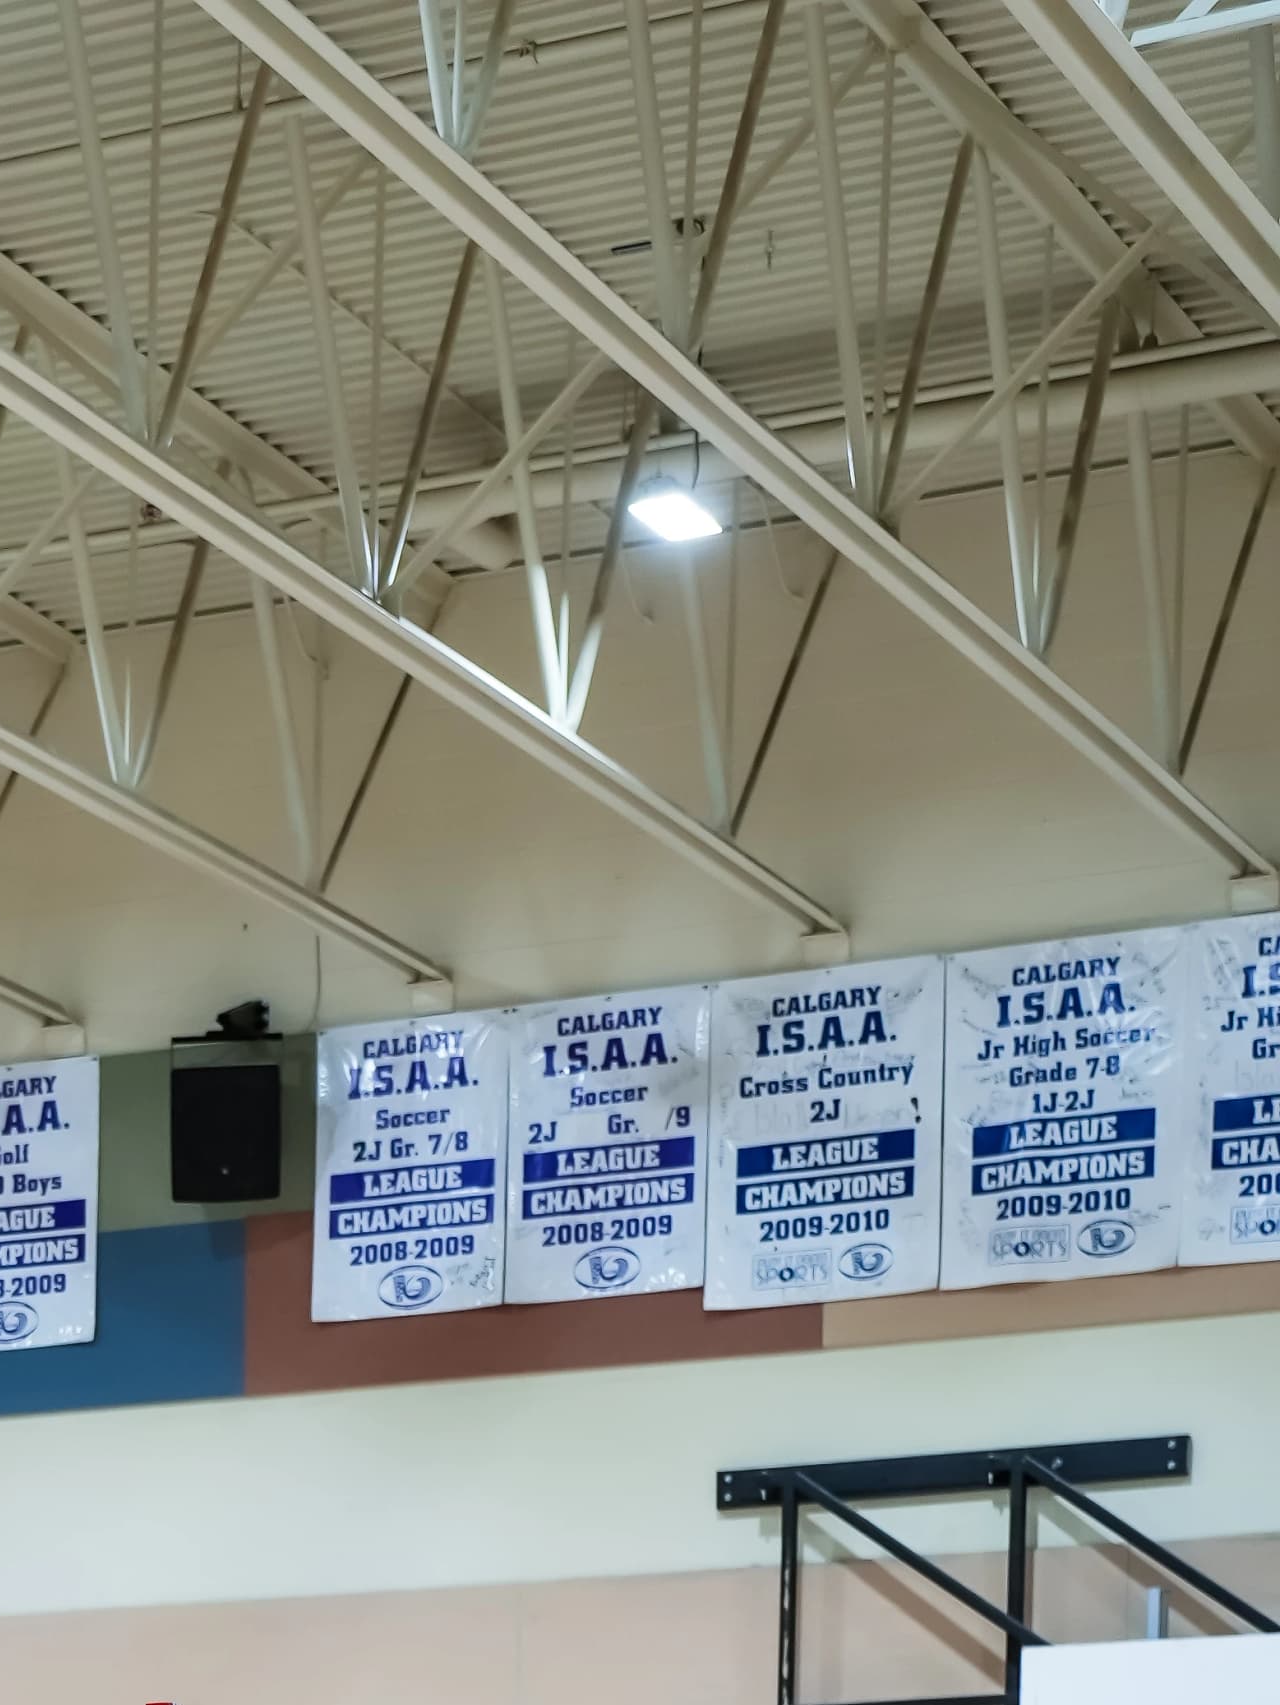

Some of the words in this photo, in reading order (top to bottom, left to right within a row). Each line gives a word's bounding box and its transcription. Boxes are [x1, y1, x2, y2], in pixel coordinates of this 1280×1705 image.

[1012, 956, 1121, 988] CALGARY
[771, 985, 882, 1019] CALGARY
[997, 982, 1137, 1028] I.S.A.A.
[557, 1006, 662, 1038] CALGARY
[756, 1010, 897, 1058] I.S.A.A.
[1220, 1010, 1248, 1032] Jr
[363, 1030, 464, 1060] CALGARY
[542, 1032, 678, 1078] I.S.A.A.
[977, 1039, 1005, 1062] Jr
[1013, 1030, 1067, 1059] High
[1076, 1024, 1157, 1050] Soccer
[348, 1056, 479, 1100] I.S.A.A.
[740, 1076, 809, 1100] Cross
[818, 1062, 915, 1090] Country
[1009, 1060, 1077, 1089] Grade
[1085, 1054, 1121, 1079] 7-8
[570, 1086, 649, 1109] Soccer
[810, 1099, 841, 1125] 2J
[1032, 1089, 1096, 1115] 1J-2J
[376, 1108, 451, 1130] Soccer
[528, 1121, 557, 1145] 2J
[607, 1114, 640, 1136] Gr.
[1008, 1115, 1118, 1151] LEAGUE
[353, 1140, 381, 1163] 2J
[390, 1138, 419, 1160] Gr.
[428, 1130, 469, 1156] 7/8
[556, 1143, 661, 1177] LEAGUE
[772, 1135, 879, 1172] LEAGUE
[13, 1174, 62, 1197] Boys
[363, 1164, 463, 1198] LEAGUE
[980, 1150, 1146, 1192] CHAMPIONS
[530, 1176, 686, 1216] CHAMPIONS
[745, 1170, 906, 1212] CHAMPIONS
[996, 1187, 1132, 1222] 2009-2010
[337, 1198, 488, 1236] CHAMPIONS
[542, 1214, 672, 1247] 2008-2009
[760, 1208, 890, 1243] 2009-2010
[350, 1234, 475, 1267] 2008-2009
